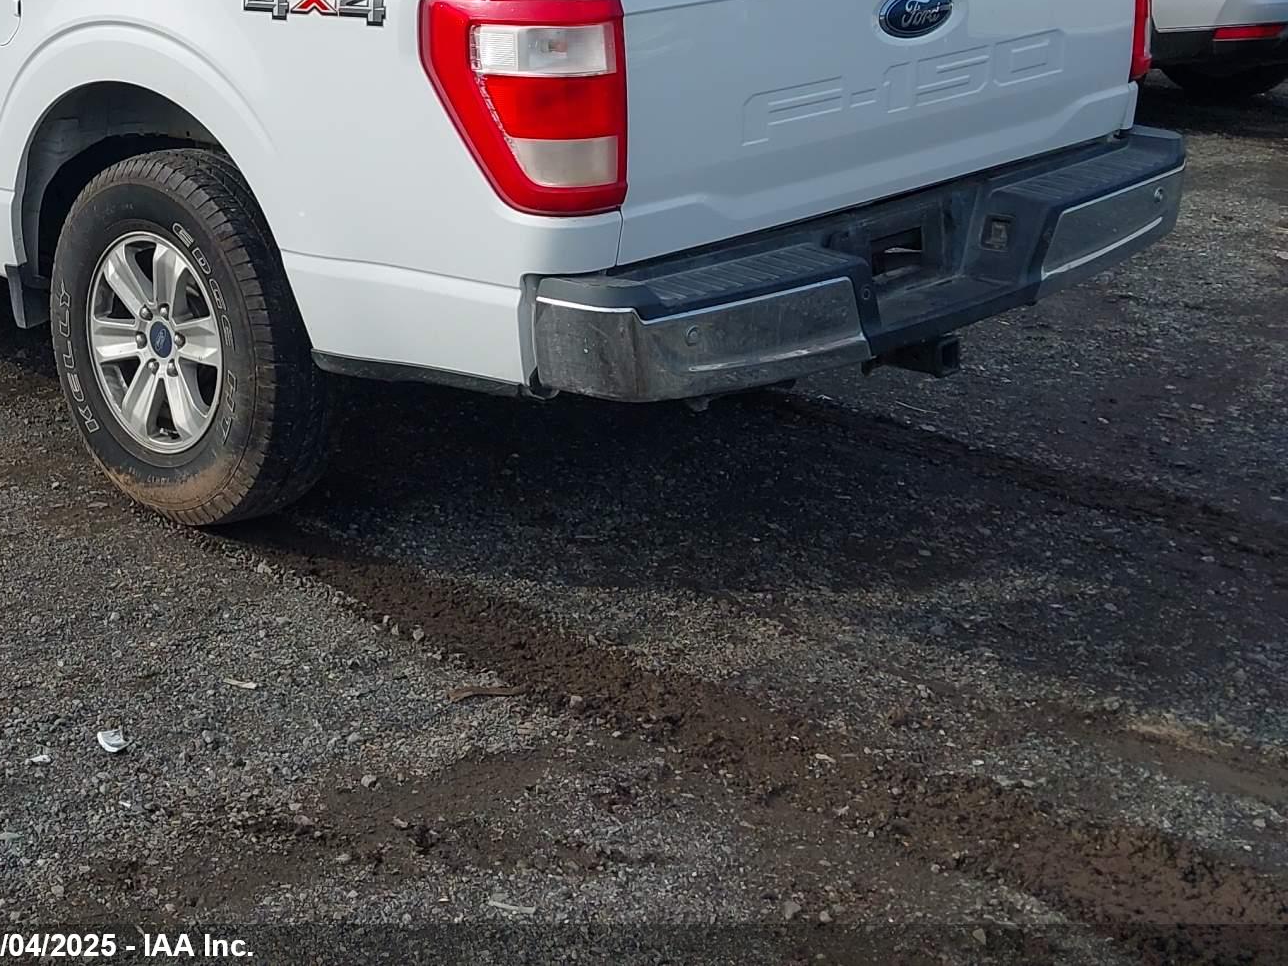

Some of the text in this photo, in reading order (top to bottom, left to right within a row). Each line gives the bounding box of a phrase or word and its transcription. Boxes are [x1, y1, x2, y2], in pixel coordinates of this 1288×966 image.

[741, 27, 1066, 147] F-150
[172, 222, 236, 354] EDGE
[59, 278, 101, 434] KELLY
